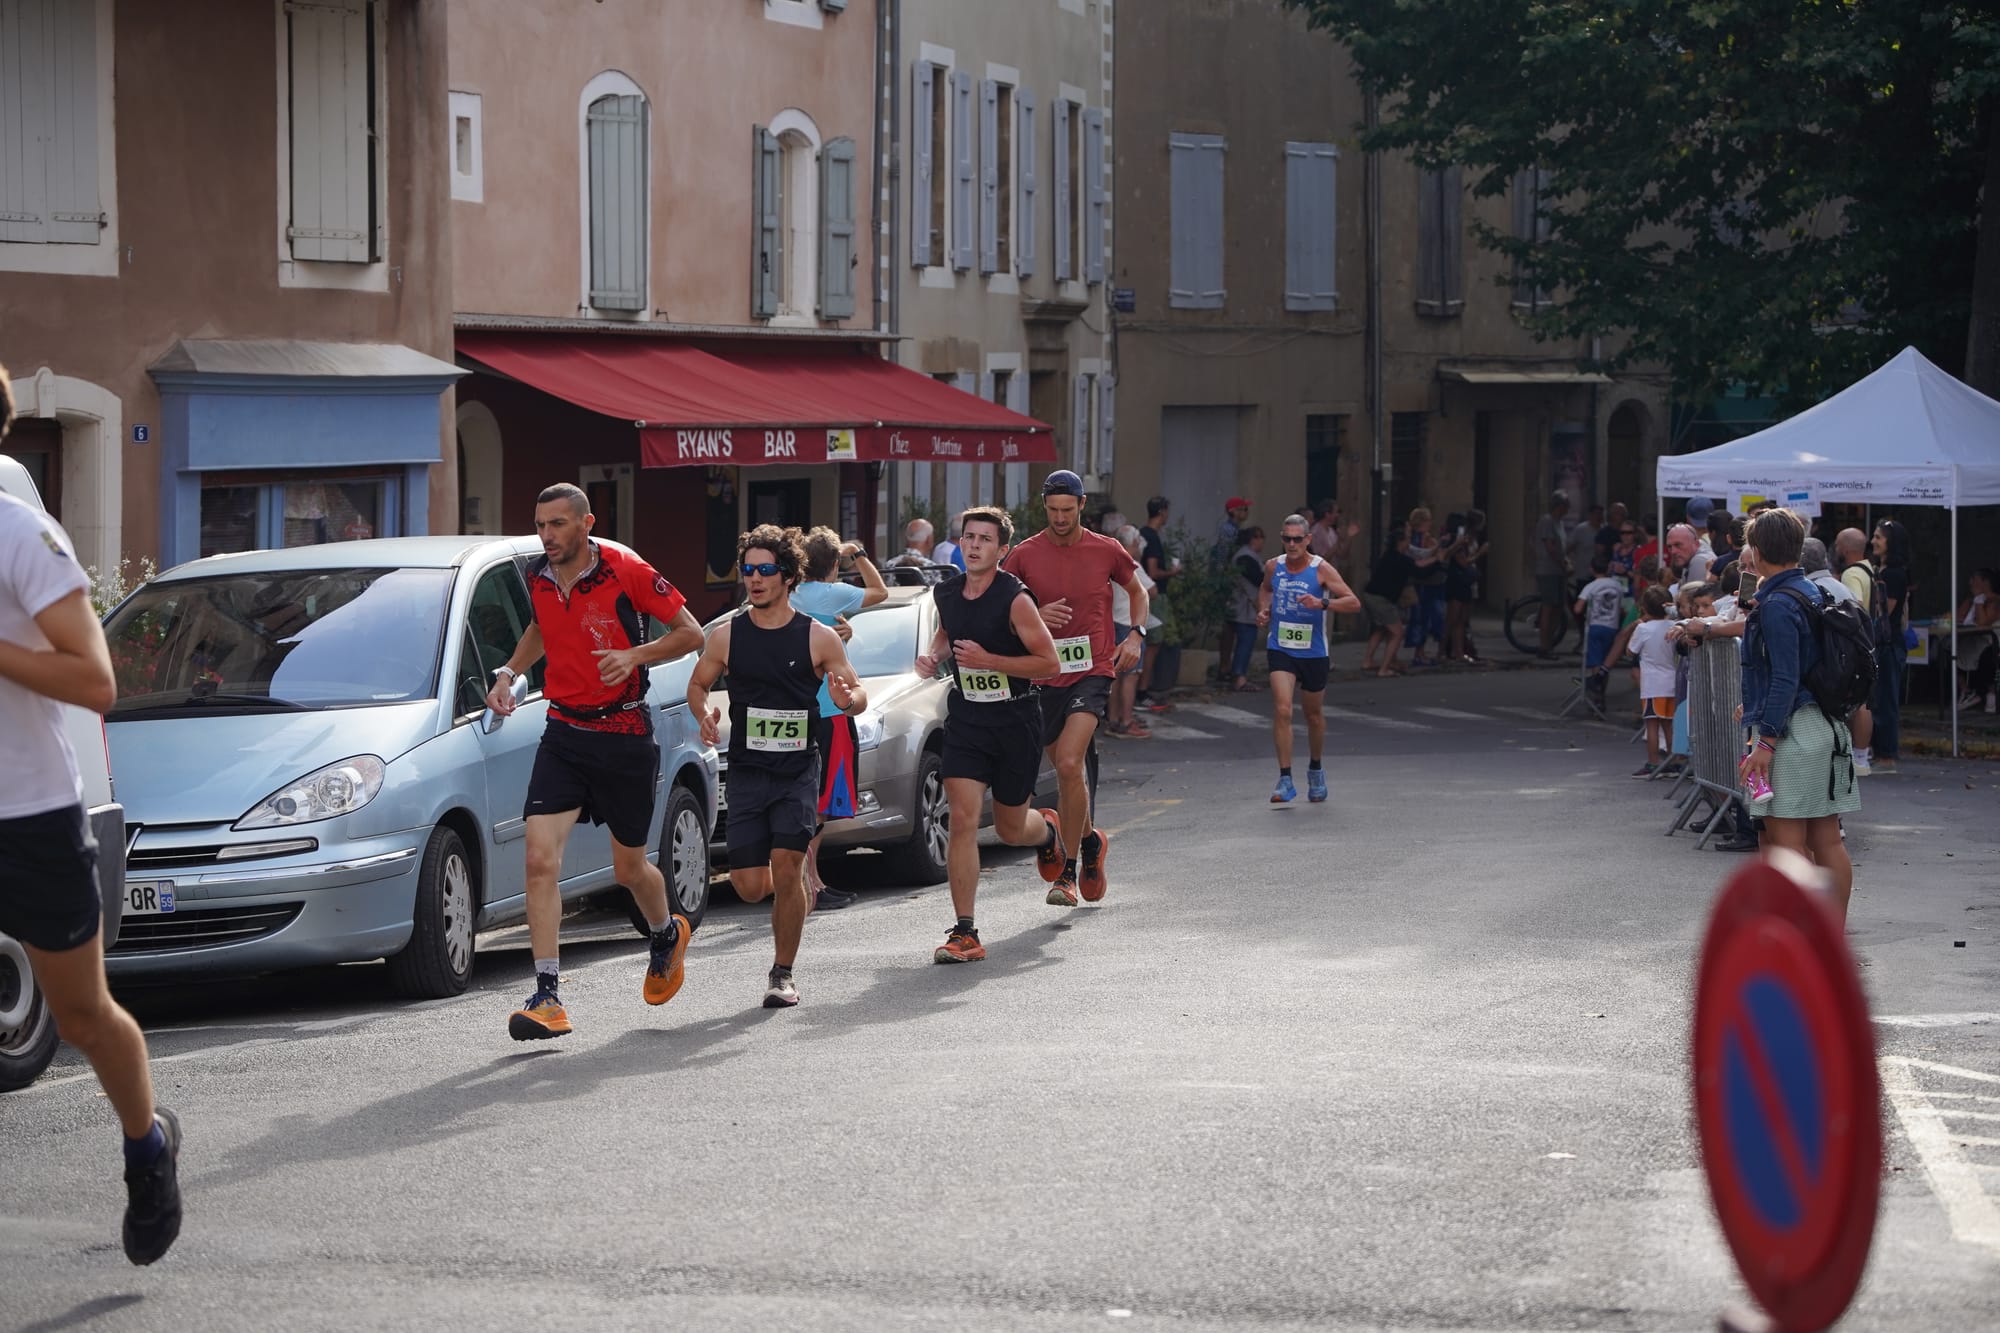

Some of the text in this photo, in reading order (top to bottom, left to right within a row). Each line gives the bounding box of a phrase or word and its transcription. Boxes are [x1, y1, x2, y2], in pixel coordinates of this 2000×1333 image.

[677, 429, 796, 458] RYAN'S BAR
[889, 432, 910, 454] Chez
[932, 436, 962, 456] Martine
[1001, 436, 1018, 460] John
[1286, 629, 1303, 641] 36
[1061, 646, 1085, 662] 10
[966, 675, 1001, 691] 186
[756, 720, 799, 738] 175
[160, 896, 173, 908] 59
